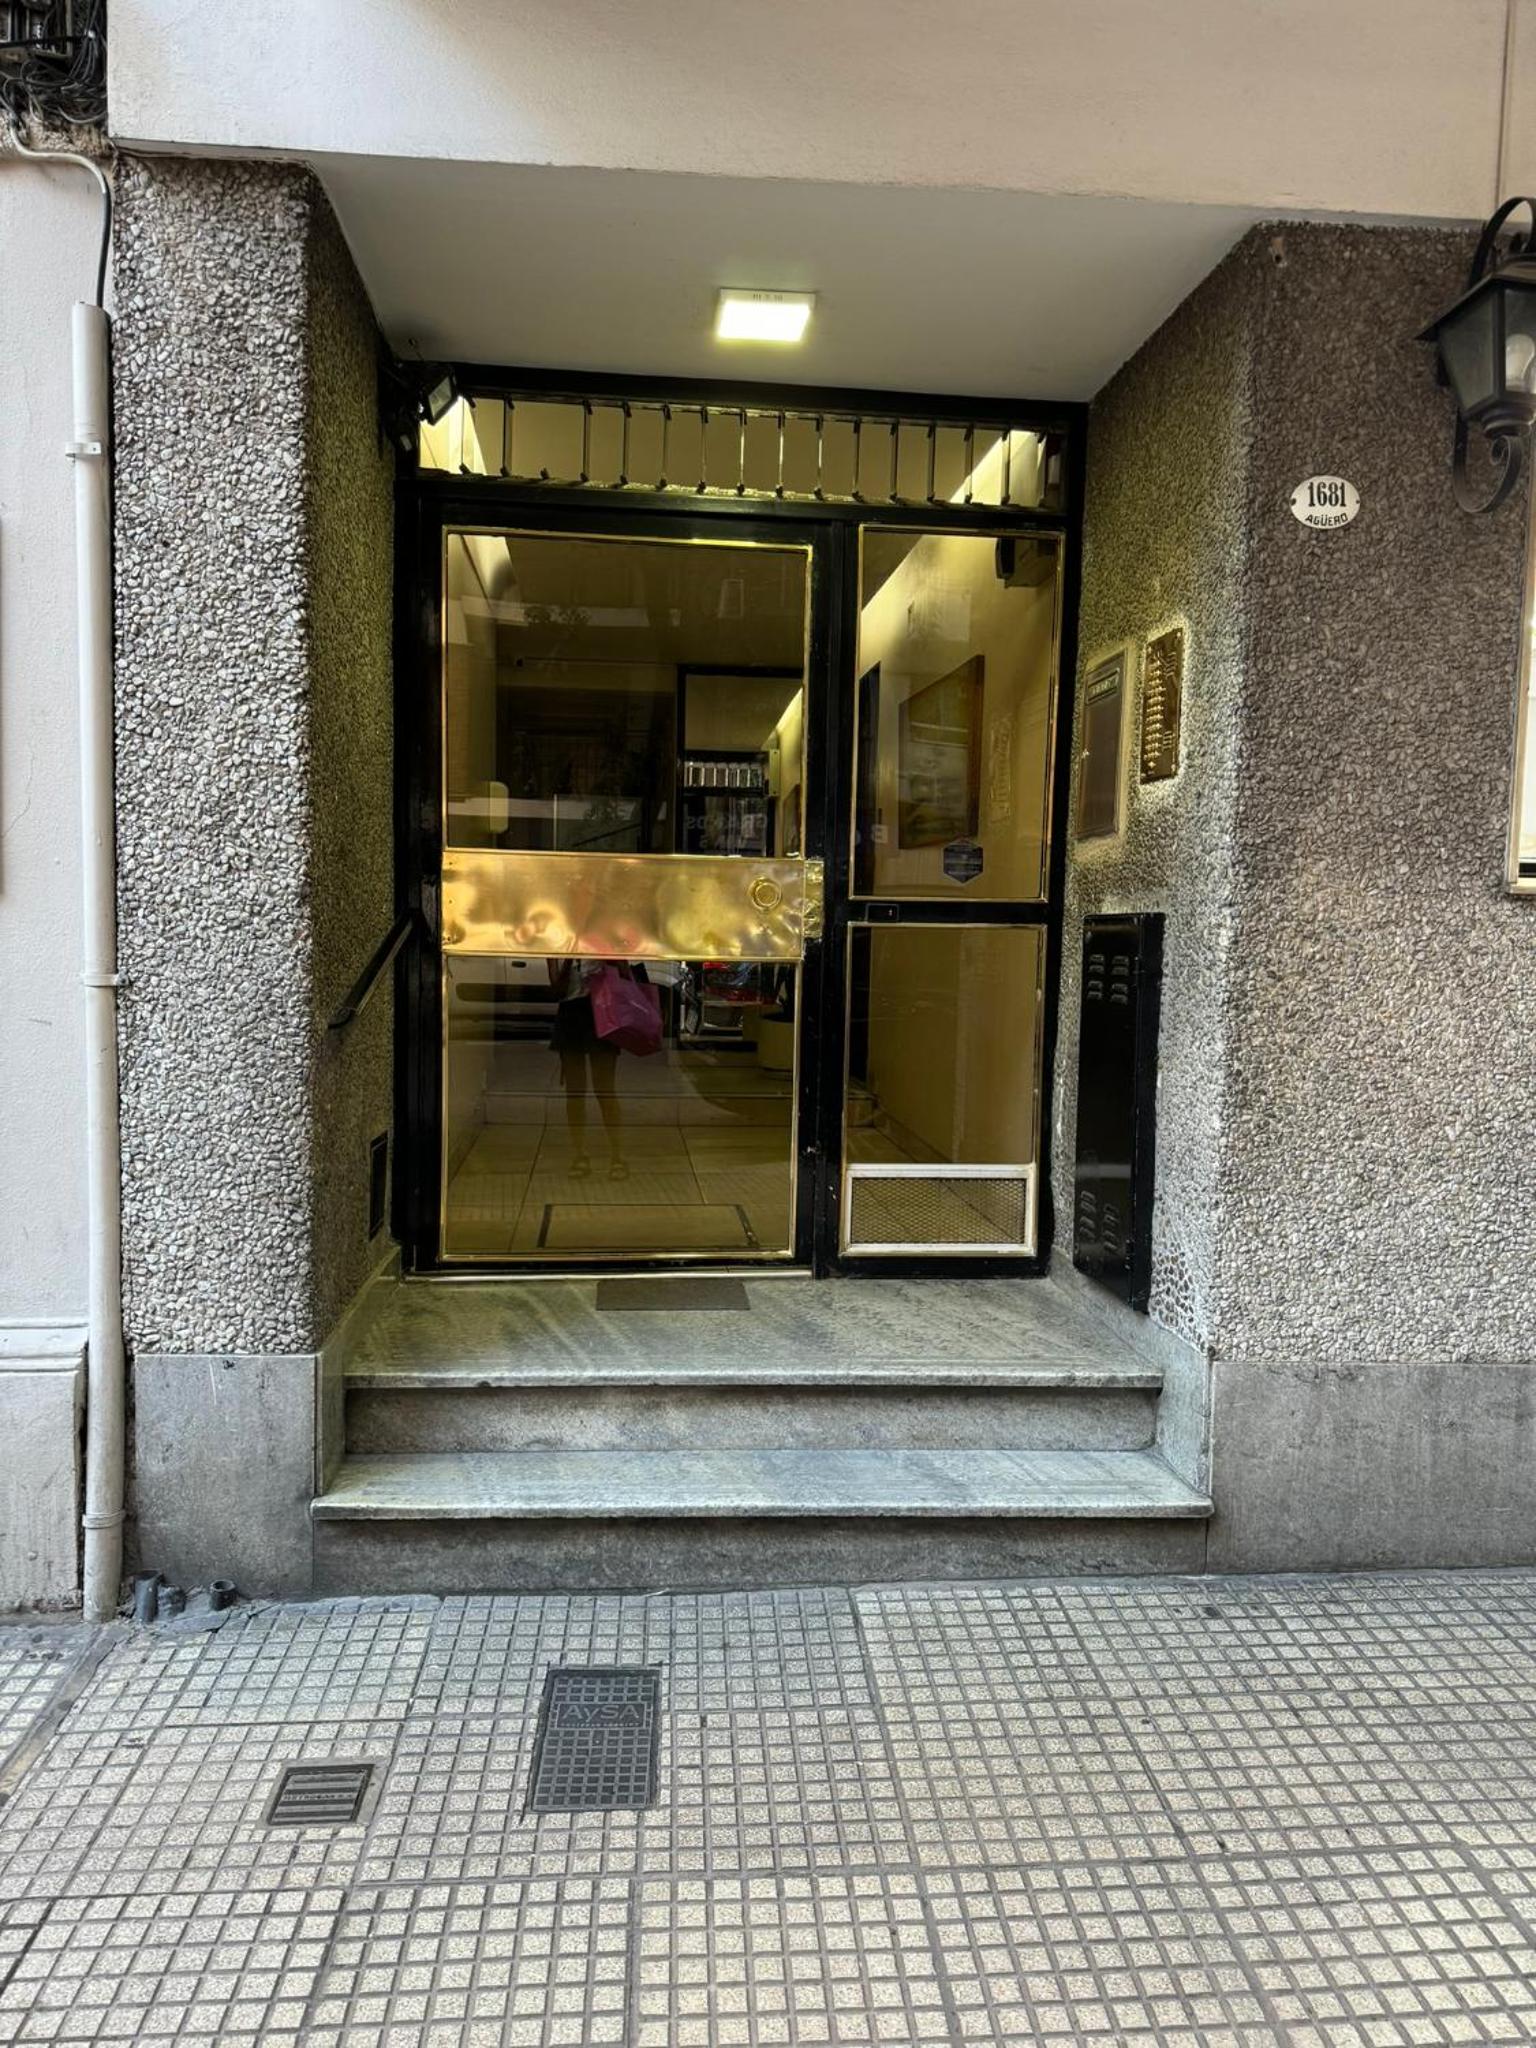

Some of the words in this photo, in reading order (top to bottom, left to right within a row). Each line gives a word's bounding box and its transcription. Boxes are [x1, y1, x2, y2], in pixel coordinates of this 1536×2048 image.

[1308, 481, 1346, 507] 1681
[1305, 512, 1348, 526] AGÜERO
[562, 1704, 640, 1723] AySA
